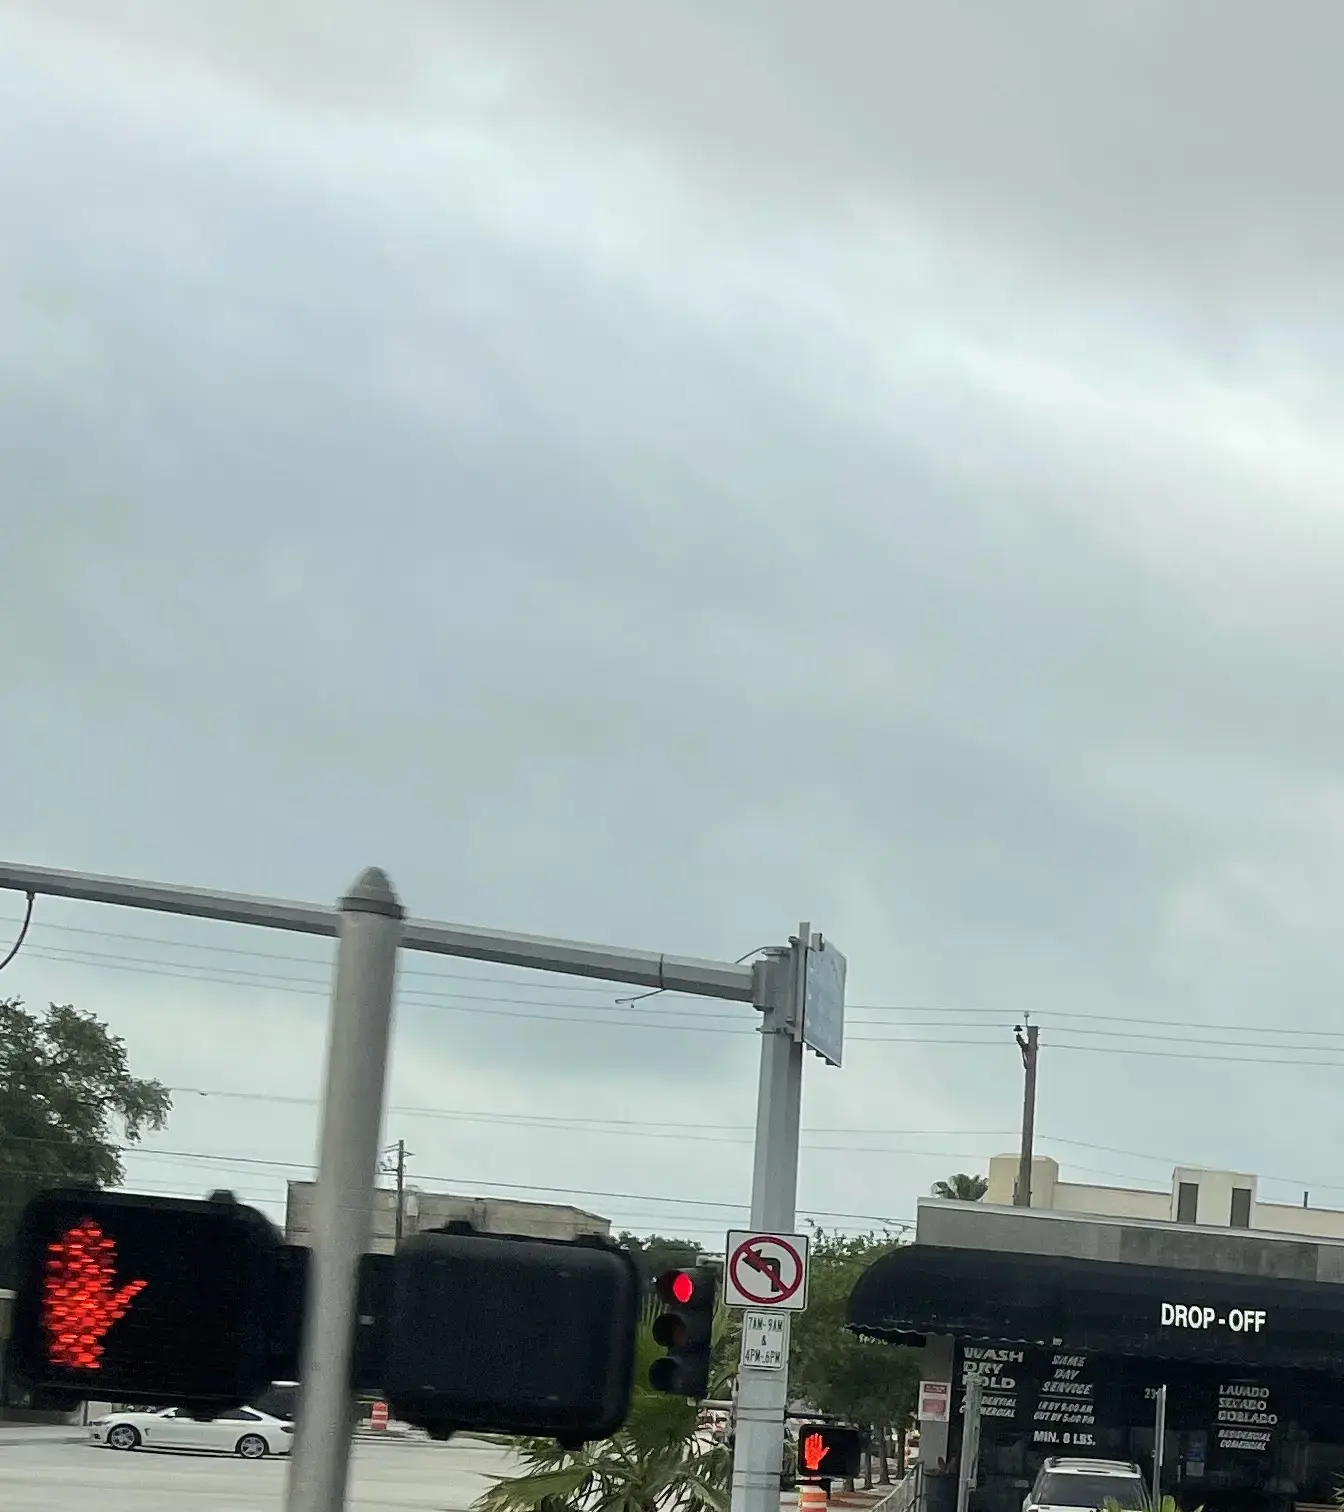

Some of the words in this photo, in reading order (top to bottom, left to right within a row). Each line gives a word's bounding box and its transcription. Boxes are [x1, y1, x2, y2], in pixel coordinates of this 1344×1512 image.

[964, 1346, 1024, 1363] WASH
[963, 1360, 1004, 1375] DRY
[1054, 1368, 1080, 1380] DAY
[1042, 1380, 1093, 1395] SERVICE
[1034, 1430, 1060, 1444] MIN.
[1073, 1433, 1096, 1446] LBS.
